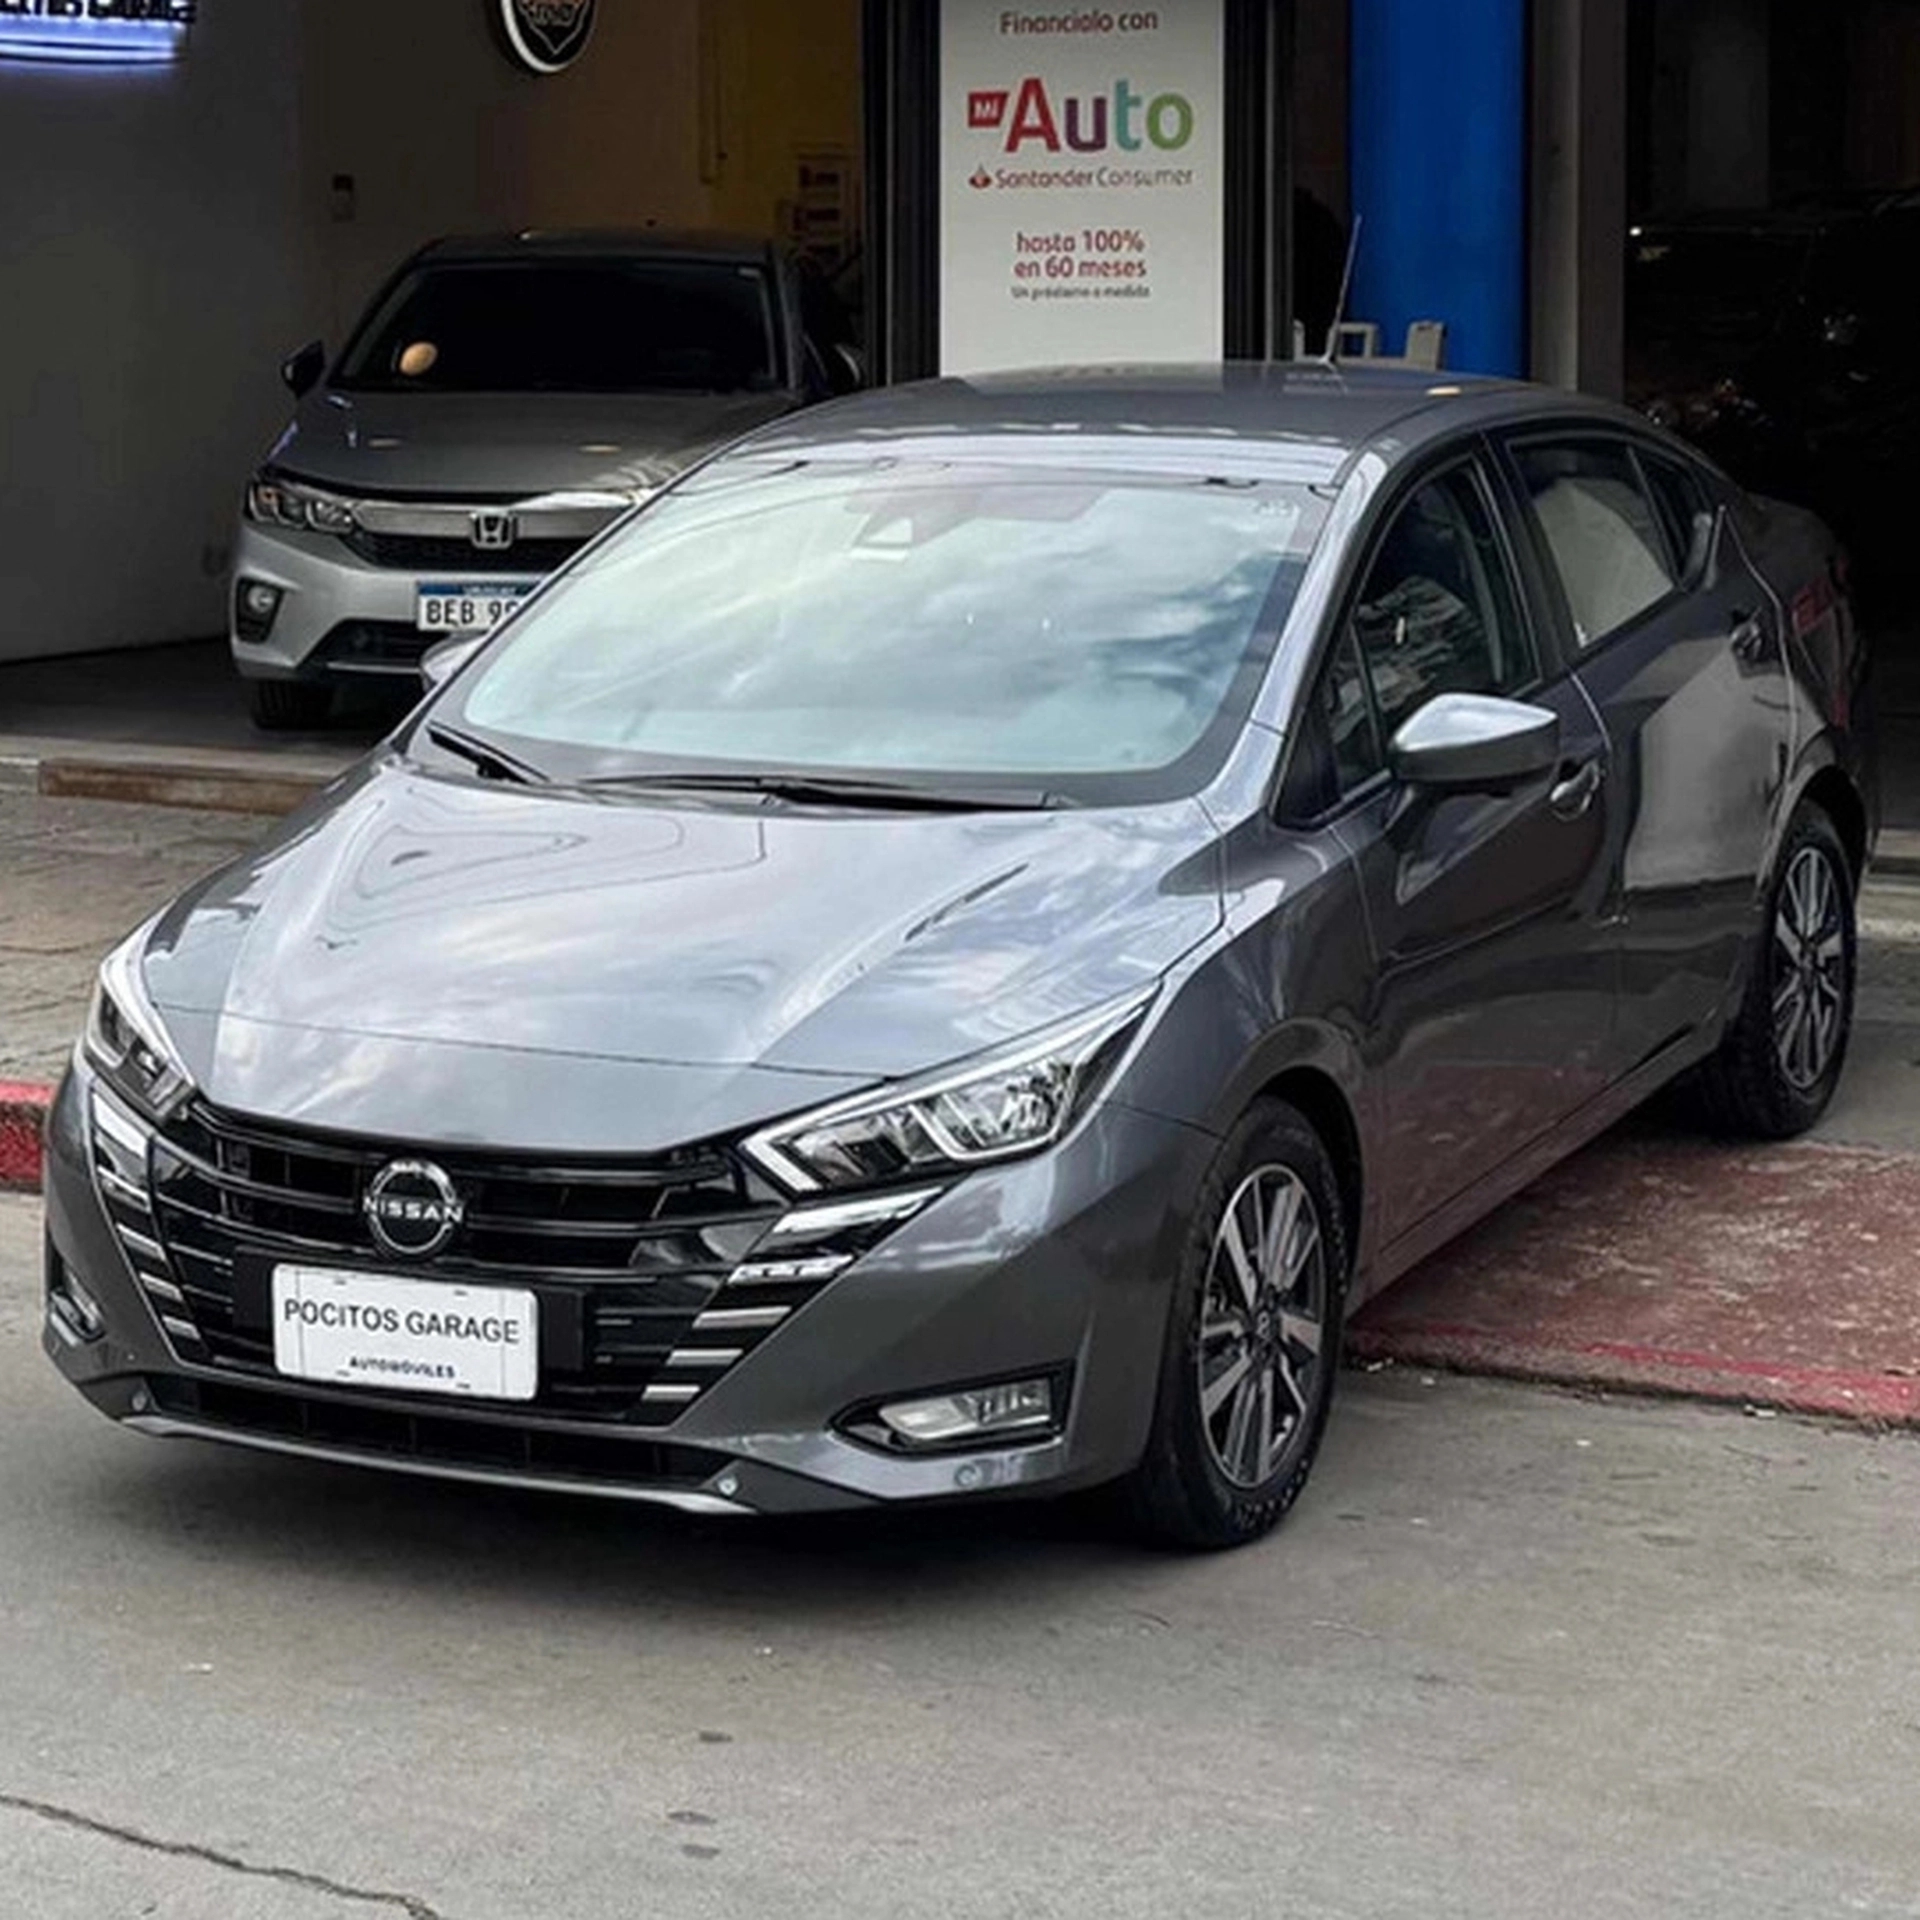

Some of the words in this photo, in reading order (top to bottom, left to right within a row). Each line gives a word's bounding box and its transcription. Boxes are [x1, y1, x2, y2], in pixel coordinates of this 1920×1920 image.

[1118, 11, 1158, 31] con
[1005, 78, 1193, 151] Auto
[995, 169, 1093, 188] Santander
[1096, 168, 1192, 187] Consumer
[1016, 232, 1075, 252] hasta
[1082, 230, 1144, 252] 100%
[1014, 259, 1040, 278] en
[1045, 257, 1074, 277] 60
[1078, 259, 1146, 277] meses
[363, 1195, 464, 1224] NISSAN
[284, 1299, 399, 1333] POCITOS
[405, 1312, 520, 1344] GARAGE
